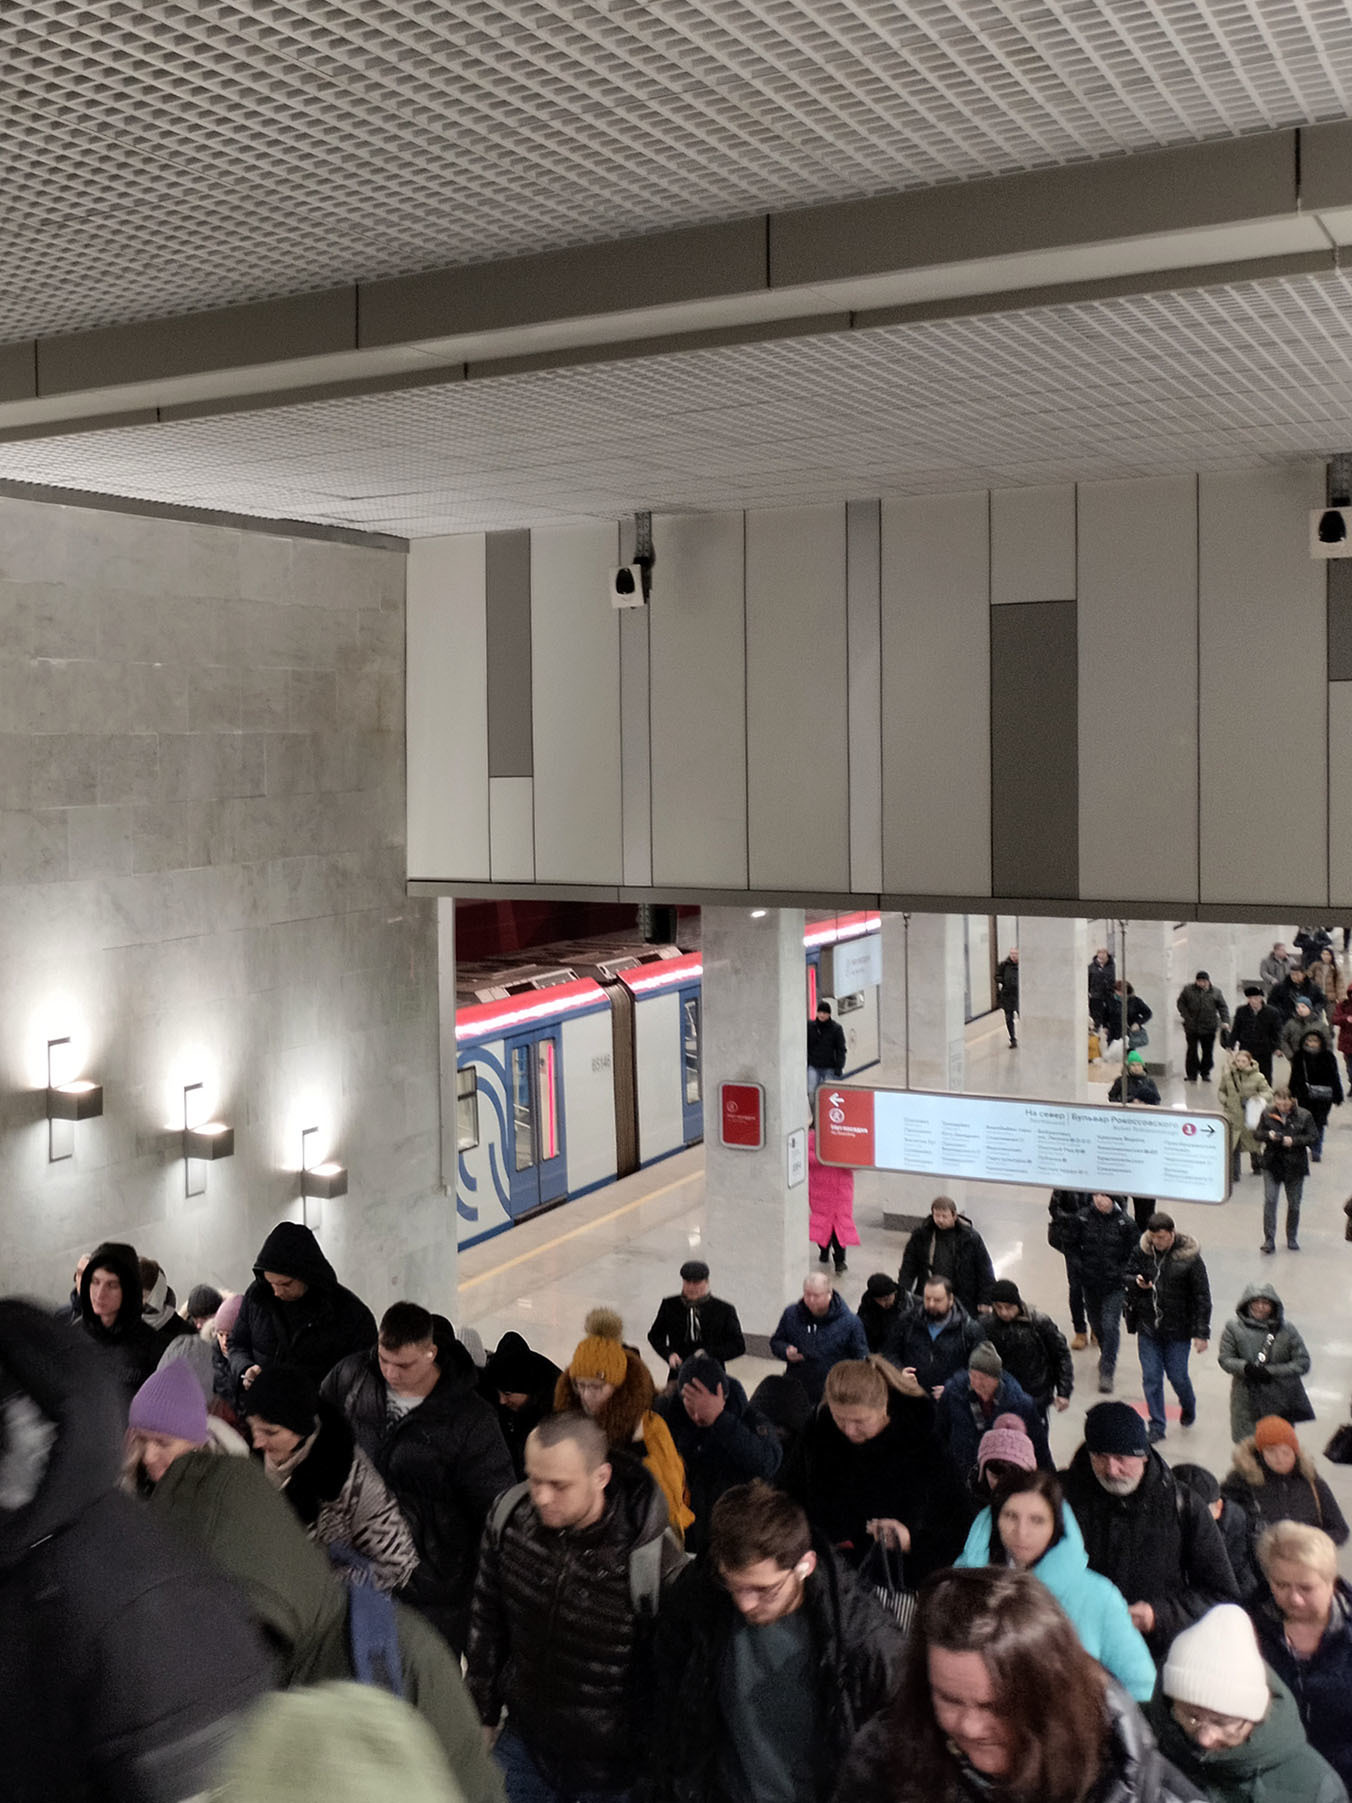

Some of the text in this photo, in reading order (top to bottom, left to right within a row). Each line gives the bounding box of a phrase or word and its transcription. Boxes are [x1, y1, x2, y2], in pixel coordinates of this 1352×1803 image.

[1025, 1107, 1066, 1120] На север
[1072, 1112, 1109, 1124] Бульвар
[1111, 1116, 1179, 1129] Рокоссовского
